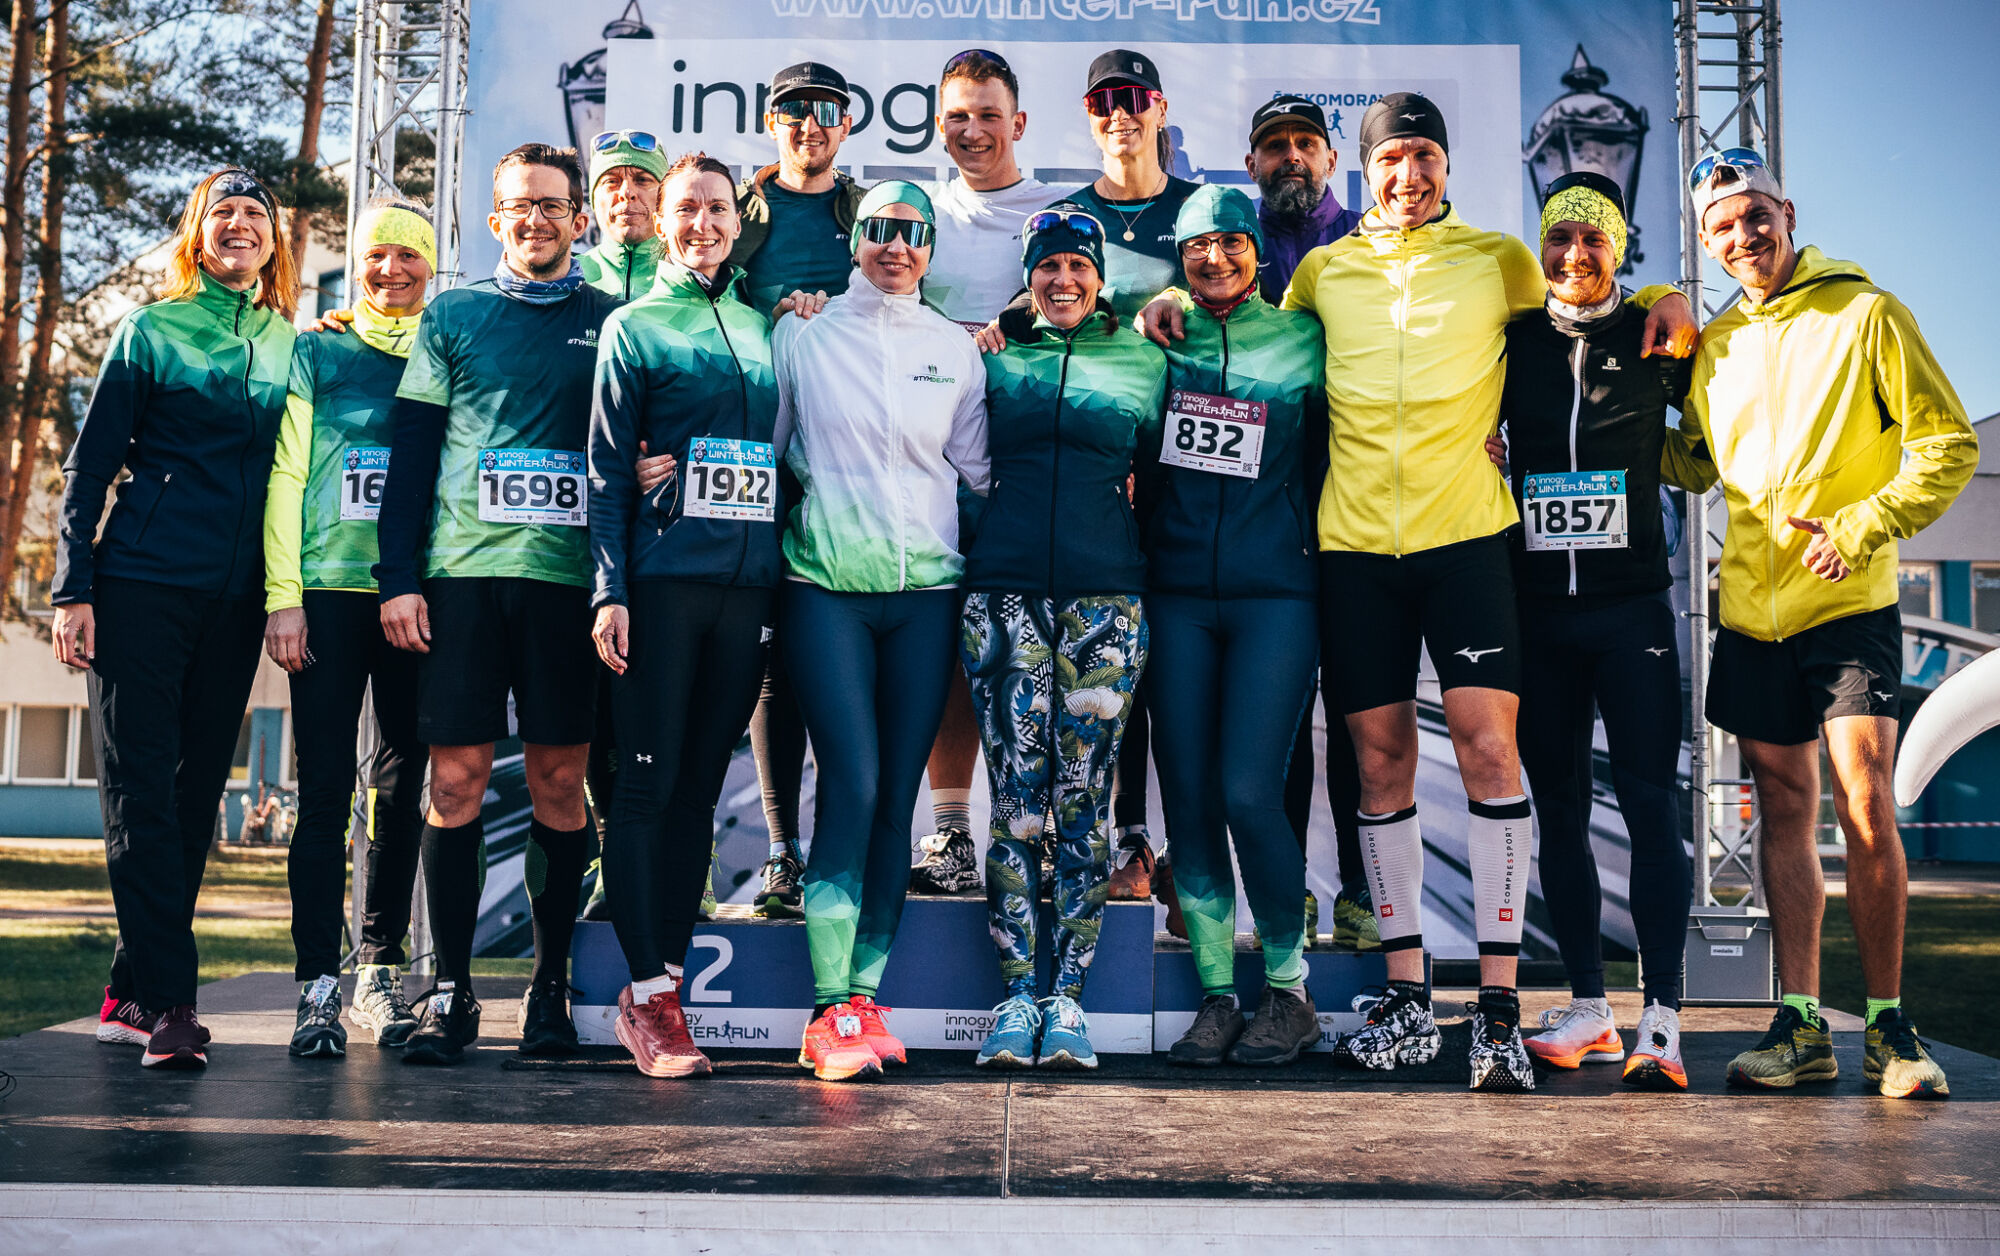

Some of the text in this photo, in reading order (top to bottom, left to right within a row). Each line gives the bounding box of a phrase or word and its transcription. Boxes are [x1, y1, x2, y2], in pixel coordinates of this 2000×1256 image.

[1183, 392, 1211, 405] innogy
[1182, 402, 1220, 415] WINTER
[1225, 408, 1249, 420] RUN
[1175, 417, 1245, 459] 832
[498, 450, 531, 460] innogy
[708, 450, 766, 463] WINTER RUN
[498, 459, 570, 470] WINTER RUN
[691, 465, 771, 504] 1922
[1538, 476, 1567, 485] innogy
[1538, 482, 1608, 493] WINTER RUN
[482, 473, 580, 510] 1698
[1527, 498, 1617, 535] 1857
[1367, 831, 1388, 902] COMPRESSPORT
[1503, 826, 1515, 904] COMPRESSPORT
[690, 934, 734, 1003] 2
[945, 1012, 997, 1029] innogy
[731, 1027, 769, 1040] RUN
